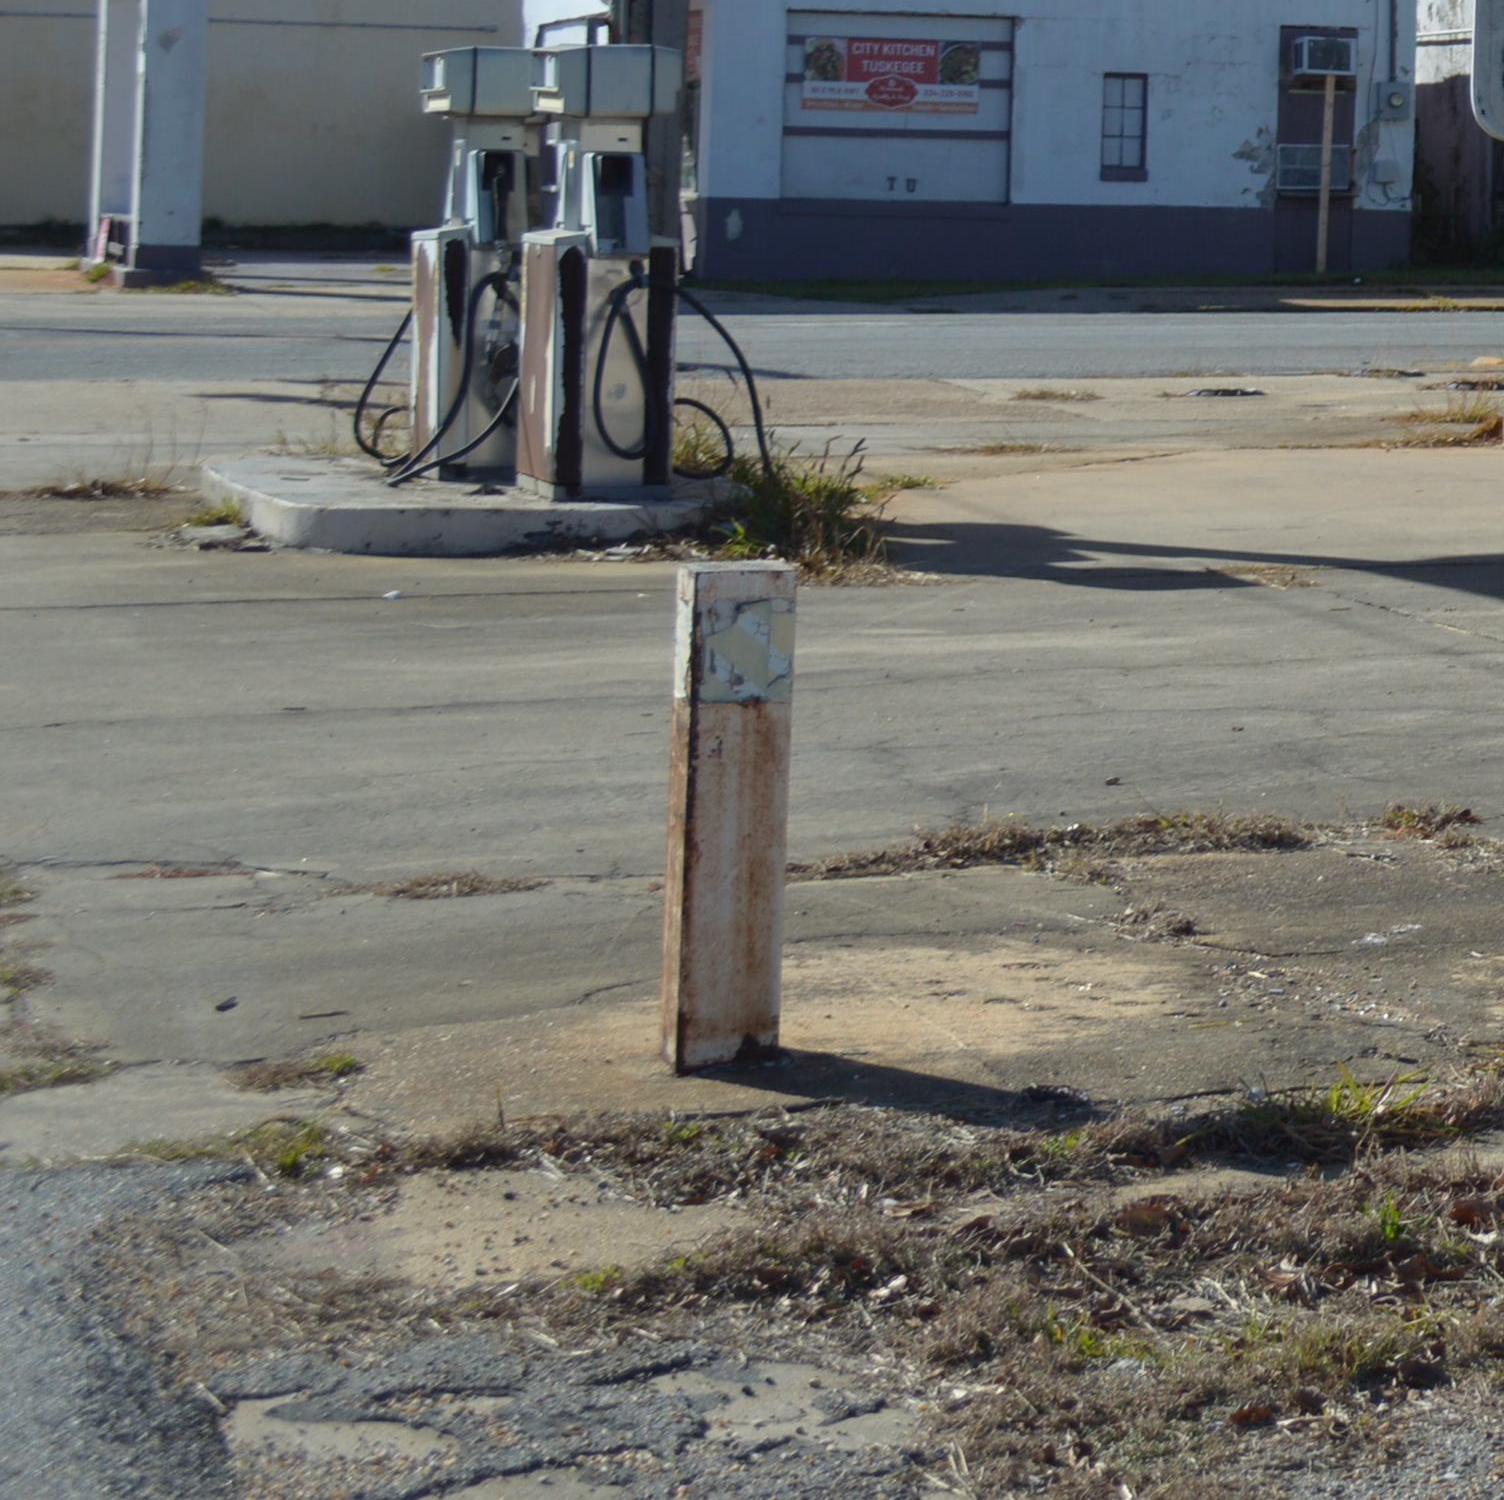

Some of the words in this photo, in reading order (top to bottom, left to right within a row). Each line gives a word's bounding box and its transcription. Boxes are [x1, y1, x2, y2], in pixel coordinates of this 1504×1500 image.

[852, 42, 881, 55] CITY
[883, 43, 935, 57] KITCHEN
[862, 60, 925, 74] TUSKEGEE
